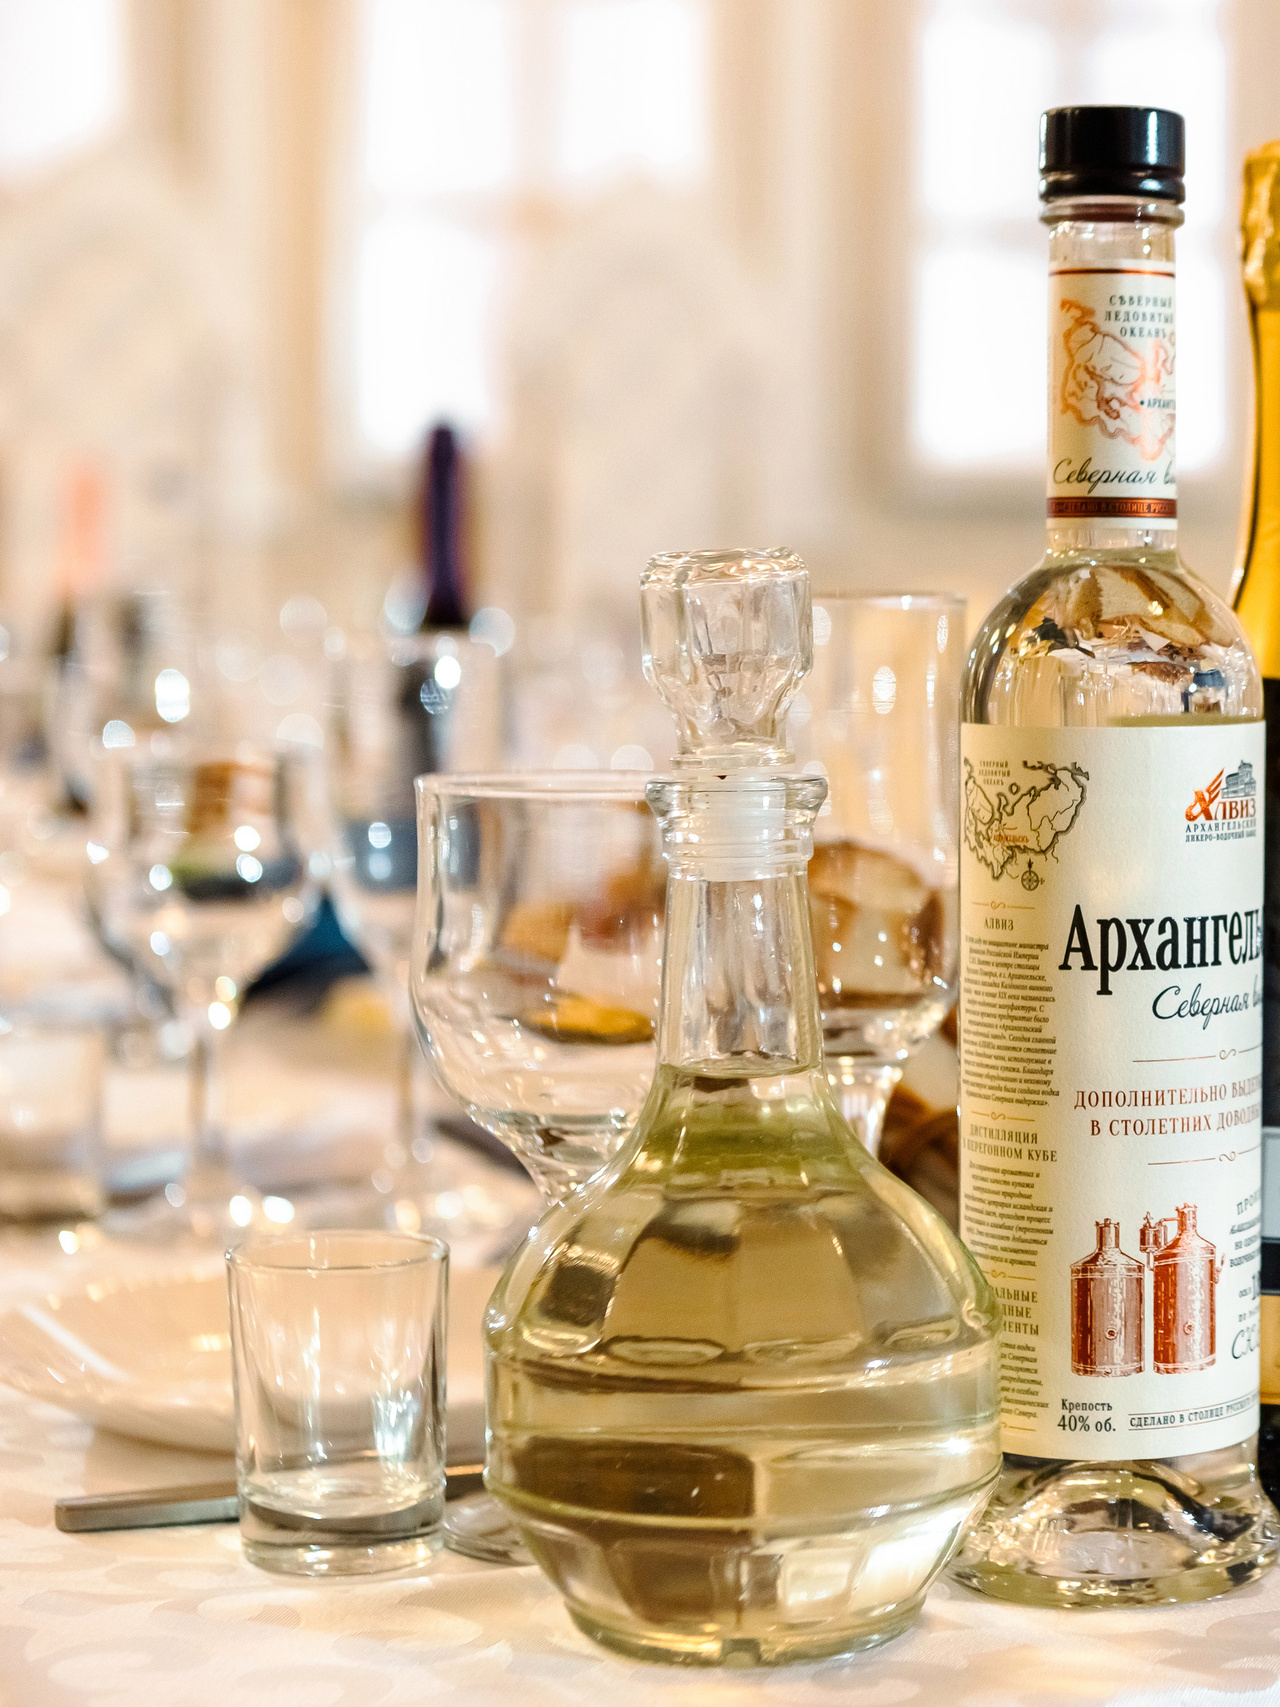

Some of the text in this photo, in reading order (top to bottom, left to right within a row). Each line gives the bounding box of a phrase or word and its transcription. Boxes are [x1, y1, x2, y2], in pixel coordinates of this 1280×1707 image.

[1053, 457, 1157, 494] Северная
[984, 917, 1015, 931] АЛВИЗ
[1152, 983, 1249, 1030] Северная
[1073, 1084, 1227, 1110] ДОПОЛНИТЕЛЬНО
[1091, 1120, 1101, 1136] В
[1109, 1114, 1212, 1136] СТОЛЕТНИХ
[1027, 1149, 1058, 1162] КУБЕ
[1061, 1398, 1113, 1414] Крепость
[1129, 1414, 1176, 1428] СДЕЛАНО
[1179, 1413, 1185, 1423] В
[1188, 1406, 1223, 1422] СТОЛИЦЕ
[1057, 1414, 1116, 1432] 40% об.
